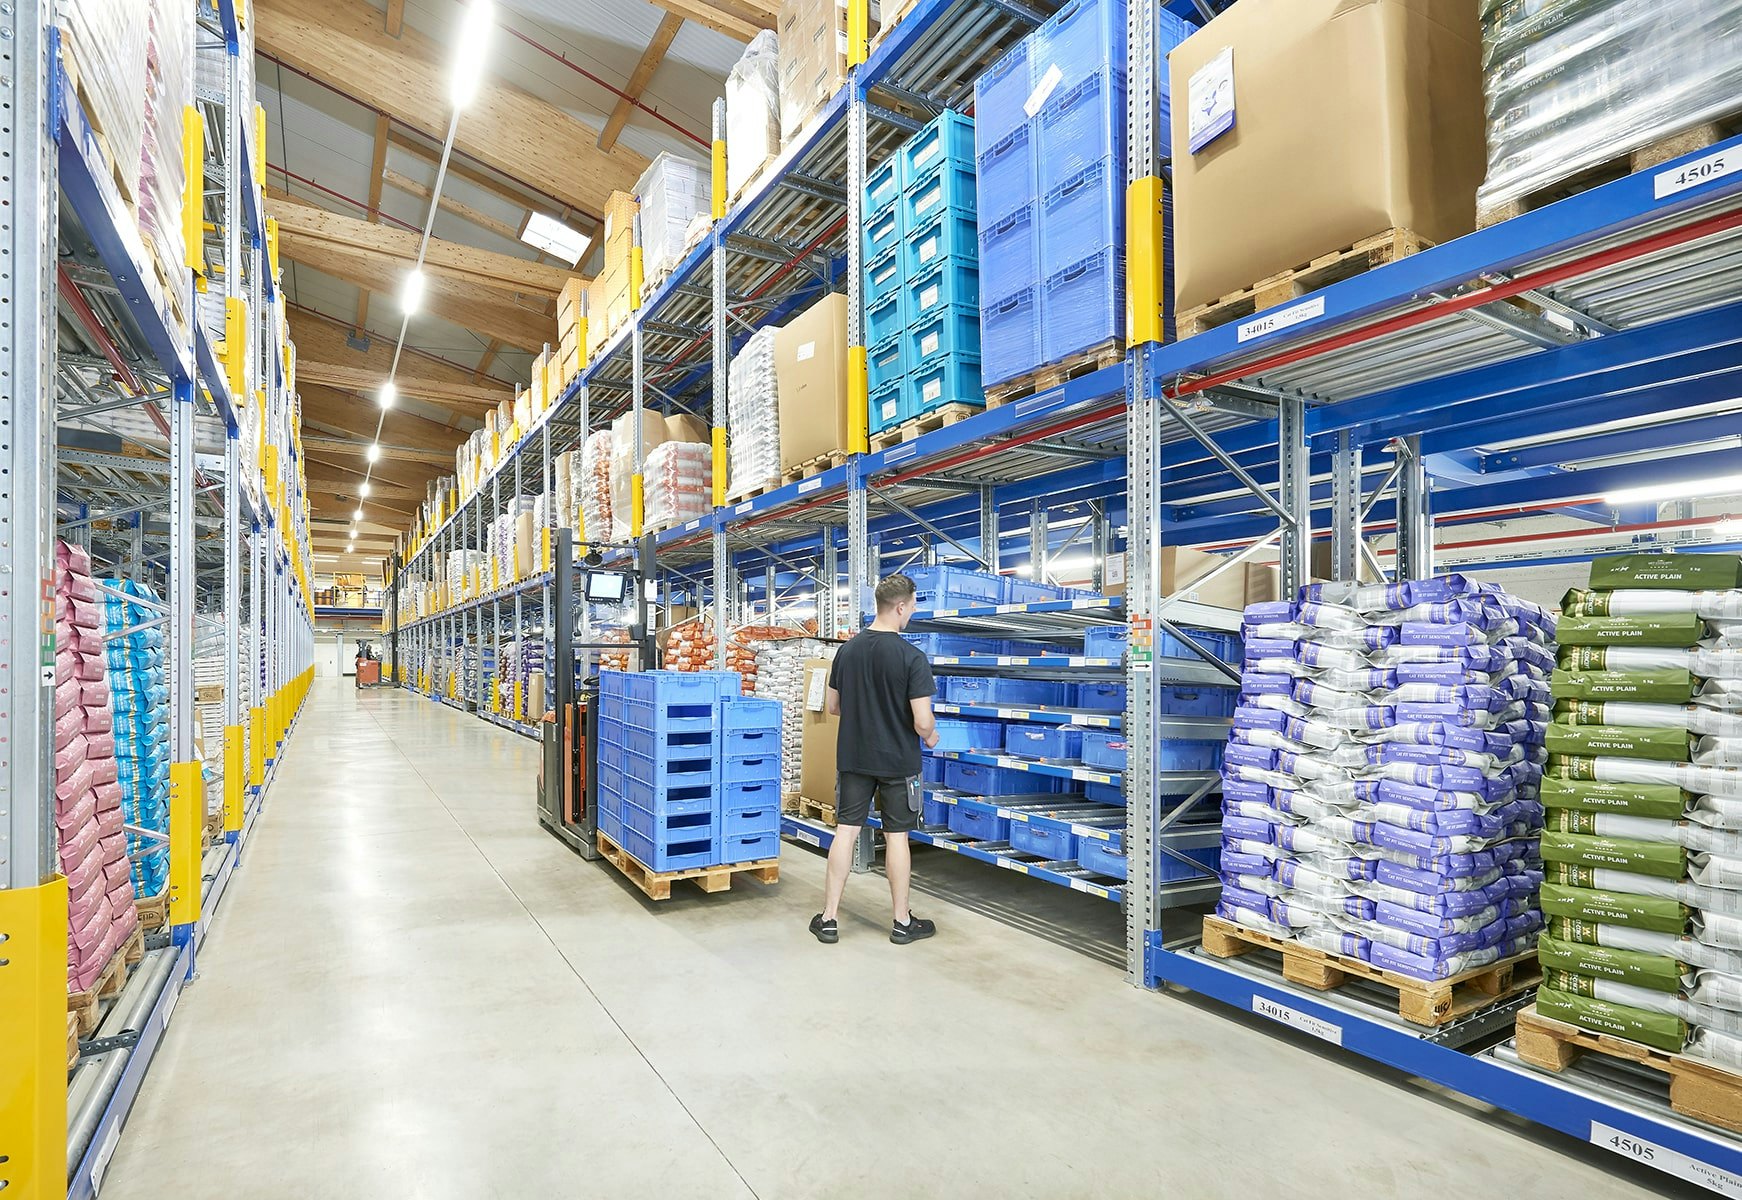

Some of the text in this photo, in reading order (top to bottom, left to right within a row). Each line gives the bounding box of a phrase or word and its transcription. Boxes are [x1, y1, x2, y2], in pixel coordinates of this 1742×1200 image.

[1674, 158, 1725, 185] 4505
[1244, 319, 1274, 337] 34015
[1582, 853, 1628, 864] ACTIVE PLAIN
[1582, 908, 1628, 920] ACTIVE PLAIN
[1579, 962, 1624, 976] ACTIVE PLAIN
[1259, 1001, 1290, 1021] 34015
[1579, 1015, 1626, 1031] ACTIVE PLAIN
[1609, 1136, 1655, 1160] 4505
[1689, 1164, 1742, 1189] Active Plain
[1706, 1178, 1724, 1190] 5kg
